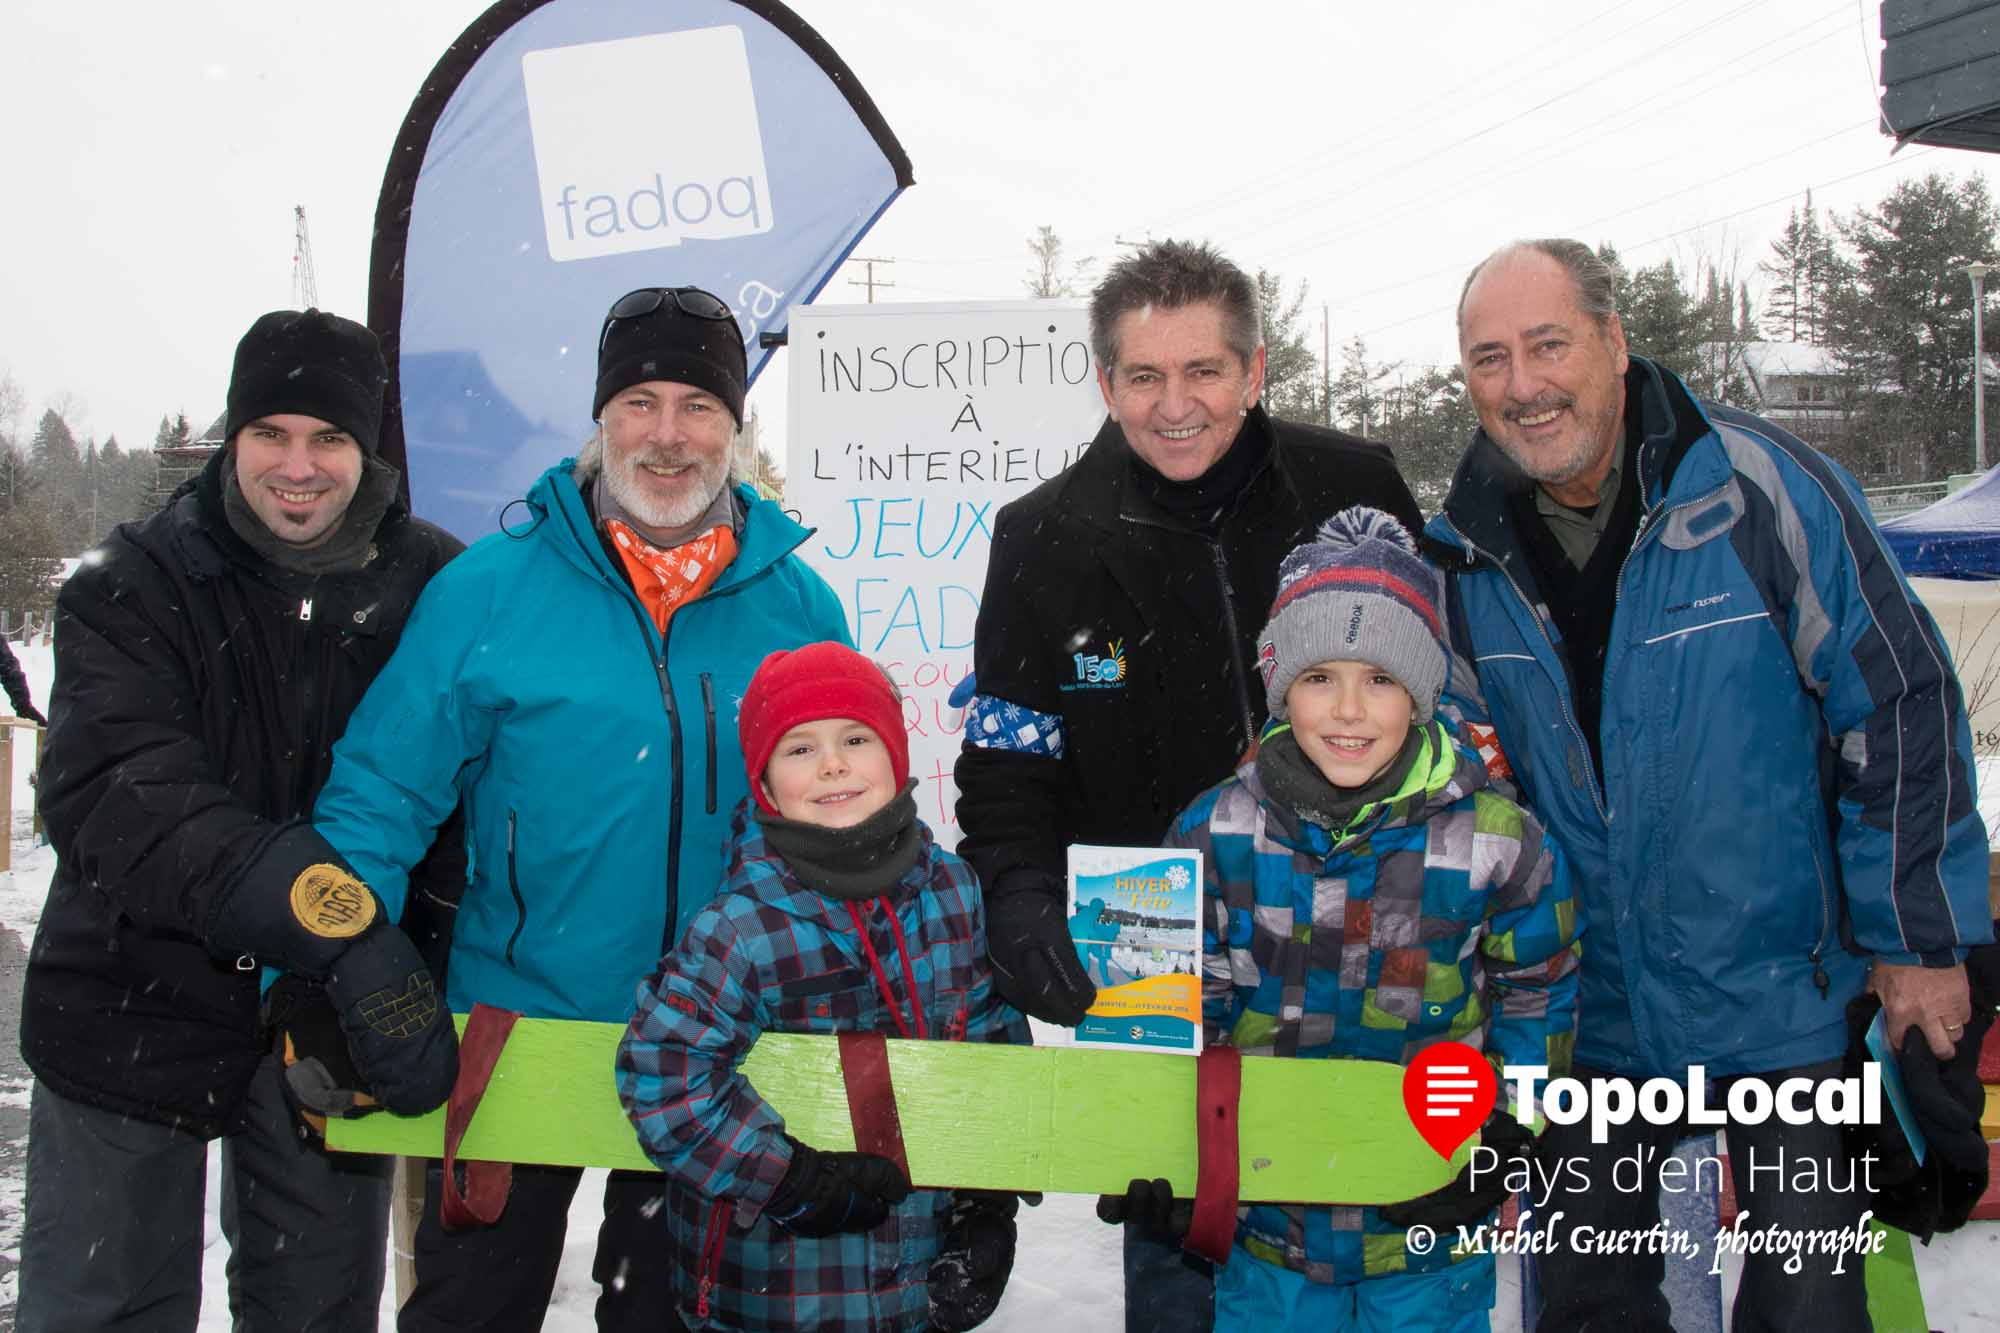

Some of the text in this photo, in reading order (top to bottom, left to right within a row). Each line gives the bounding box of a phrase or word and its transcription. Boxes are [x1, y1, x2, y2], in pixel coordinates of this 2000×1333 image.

[556, 172, 762, 241] fadoq
[950, 394, 982, 433] À
[824, 497, 993, 560] JEUX
[1345, 603, 1364, 644] Reebok
[1073, 652, 1120, 683] 150
[1115, 877, 1171, 893] HIVER
